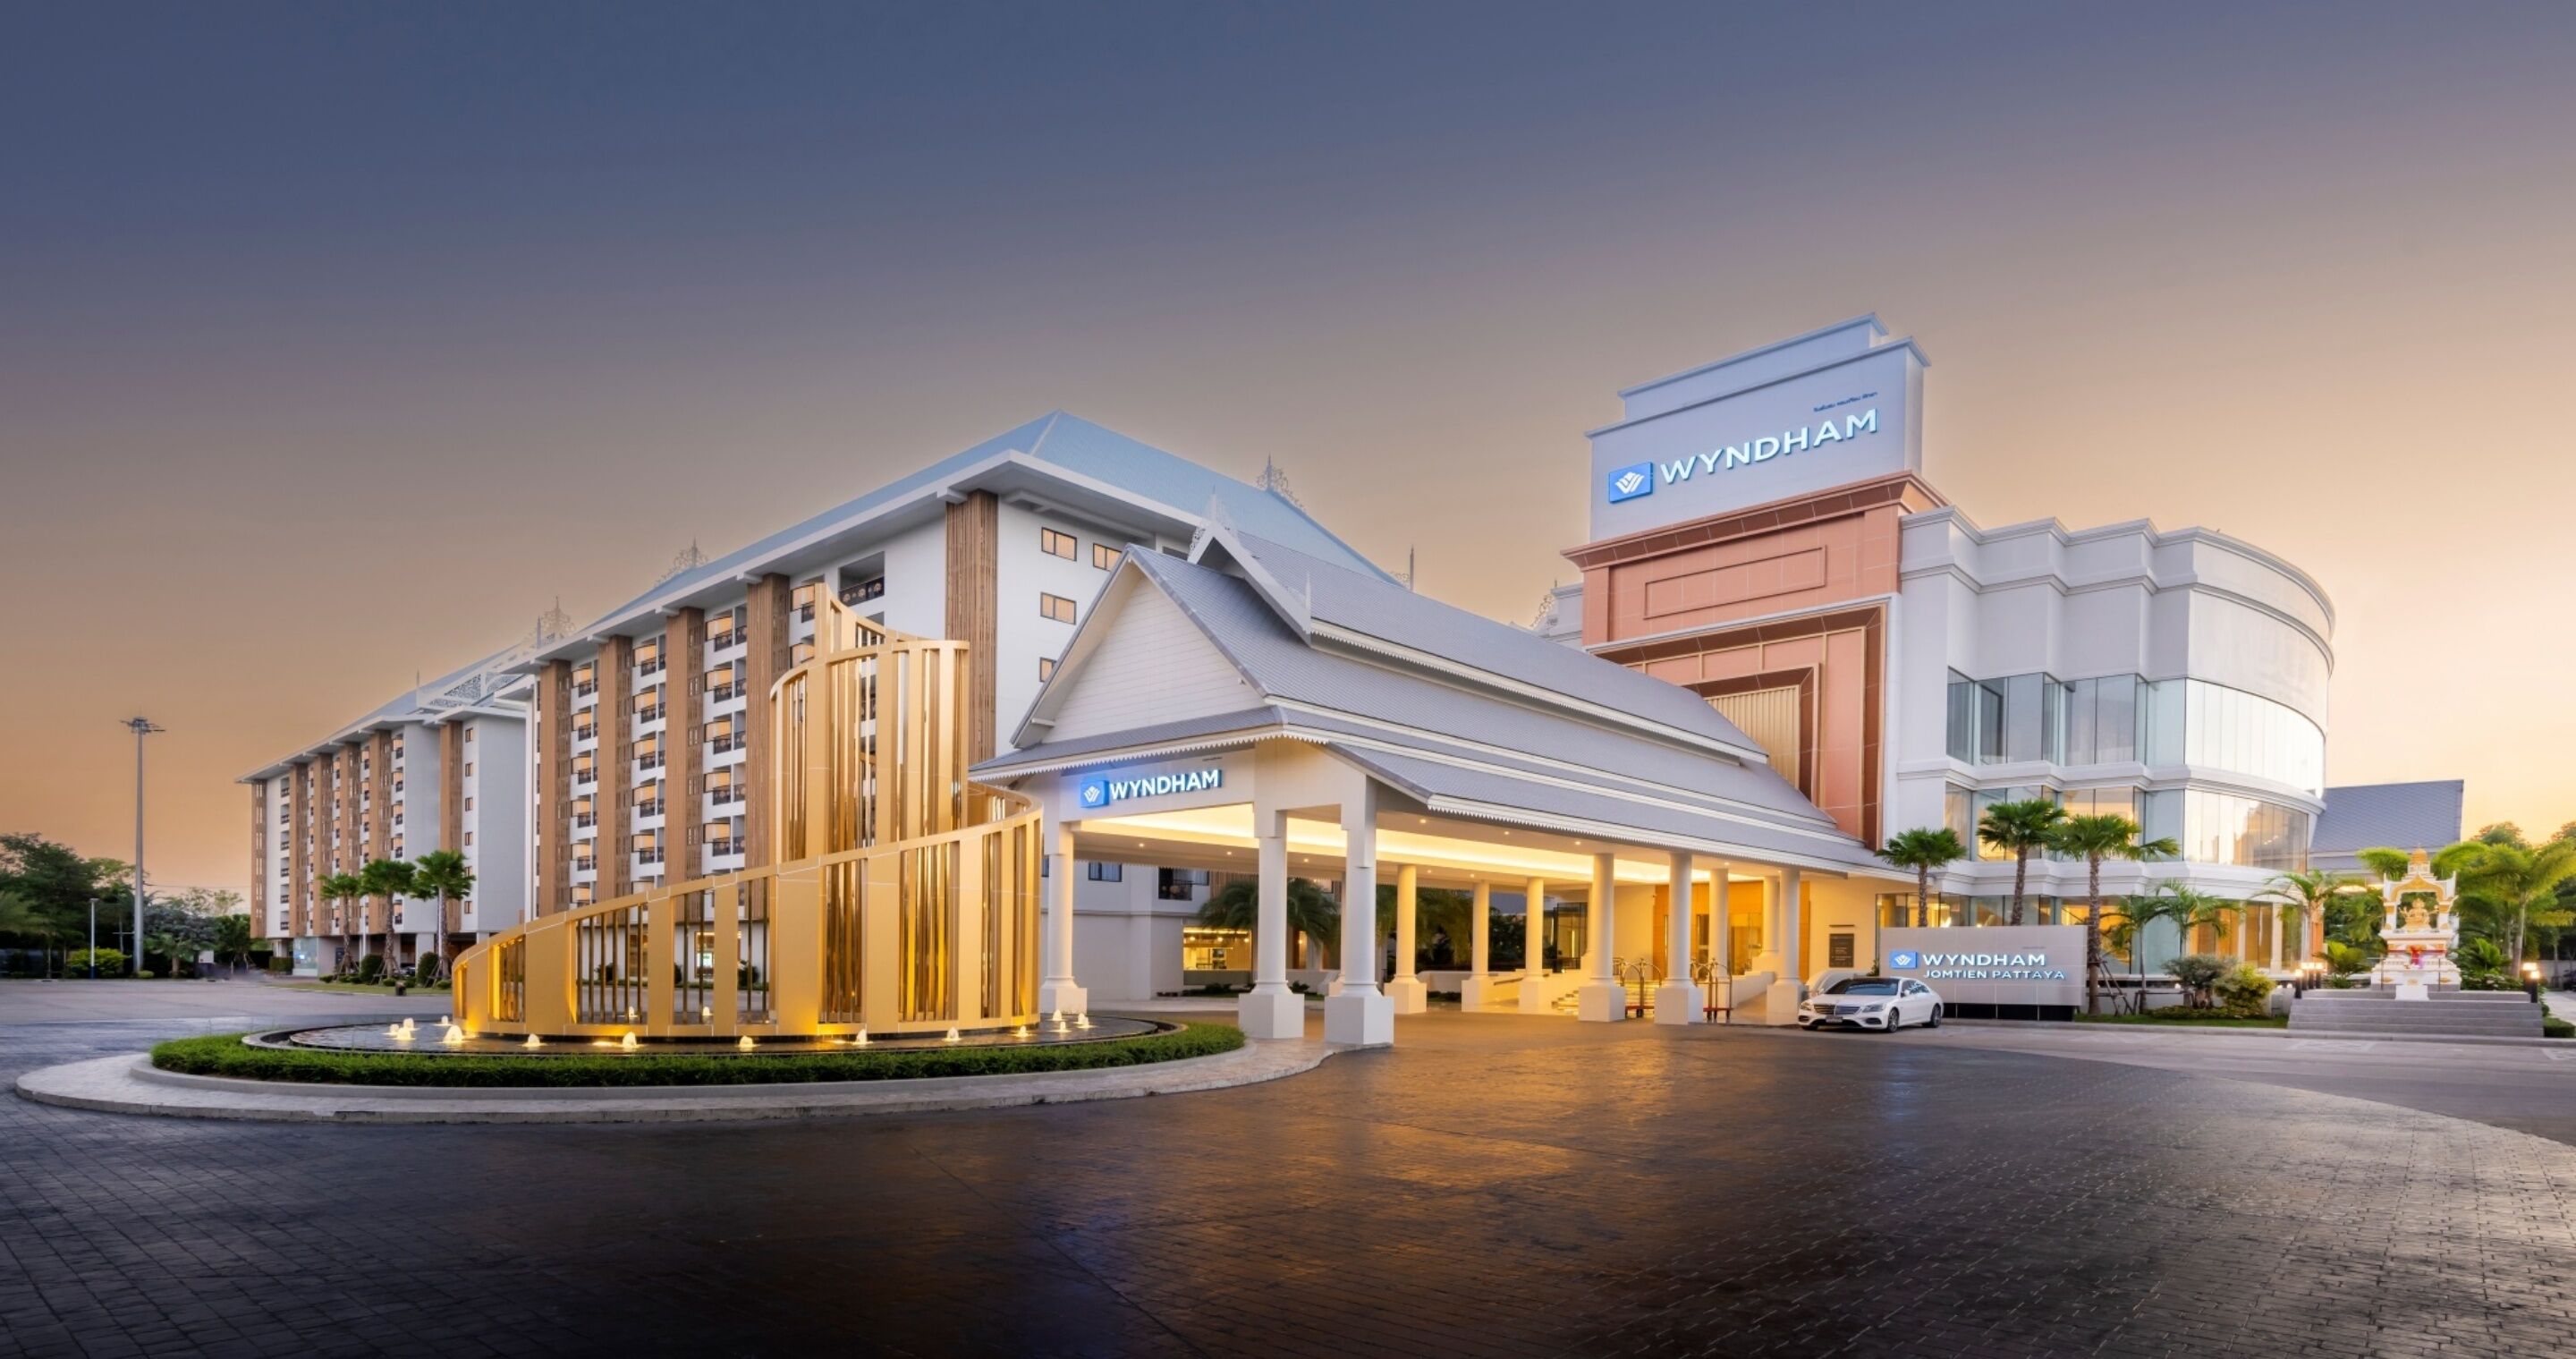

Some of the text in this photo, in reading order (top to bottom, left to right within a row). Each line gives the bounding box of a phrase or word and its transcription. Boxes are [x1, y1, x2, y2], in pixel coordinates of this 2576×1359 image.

[1659, 407, 1877, 484] WYNDHAM
[1110, 769, 1221, 800] WYNDHAM
[1922, 954, 2046, 966] WYNDHAM
[1923, 970, 2065, 980] JOMTIEN PATTAYA
